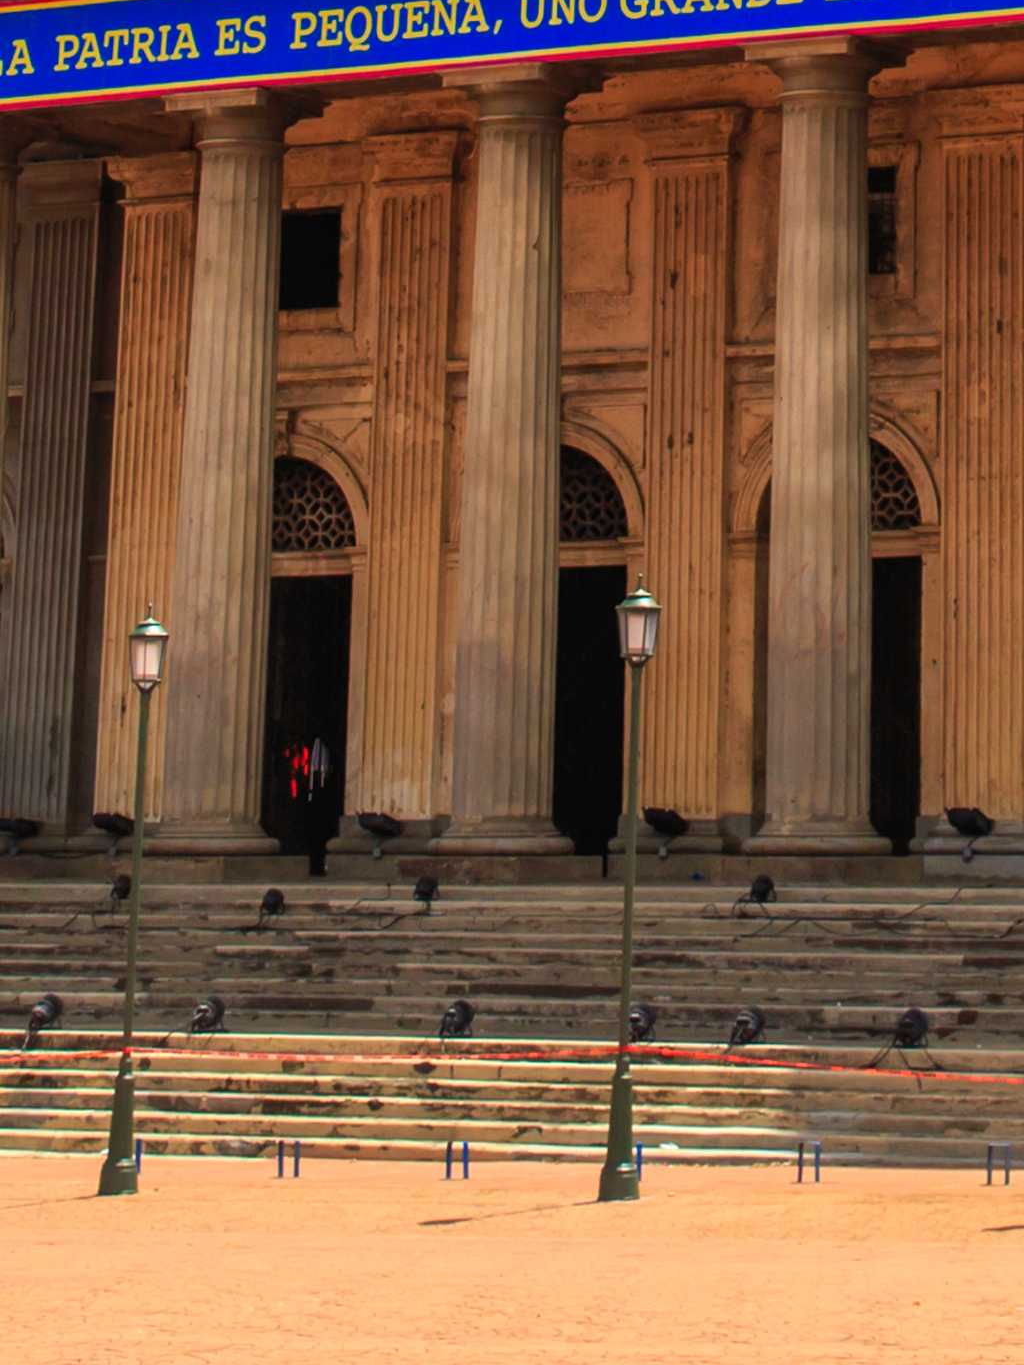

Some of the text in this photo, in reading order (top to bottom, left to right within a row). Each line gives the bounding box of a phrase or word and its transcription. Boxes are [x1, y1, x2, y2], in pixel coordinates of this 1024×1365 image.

[0, 38, 35, 77] A
[53, 22, 201, 72] PATRIA
[213, 14, 267, 57] ES
